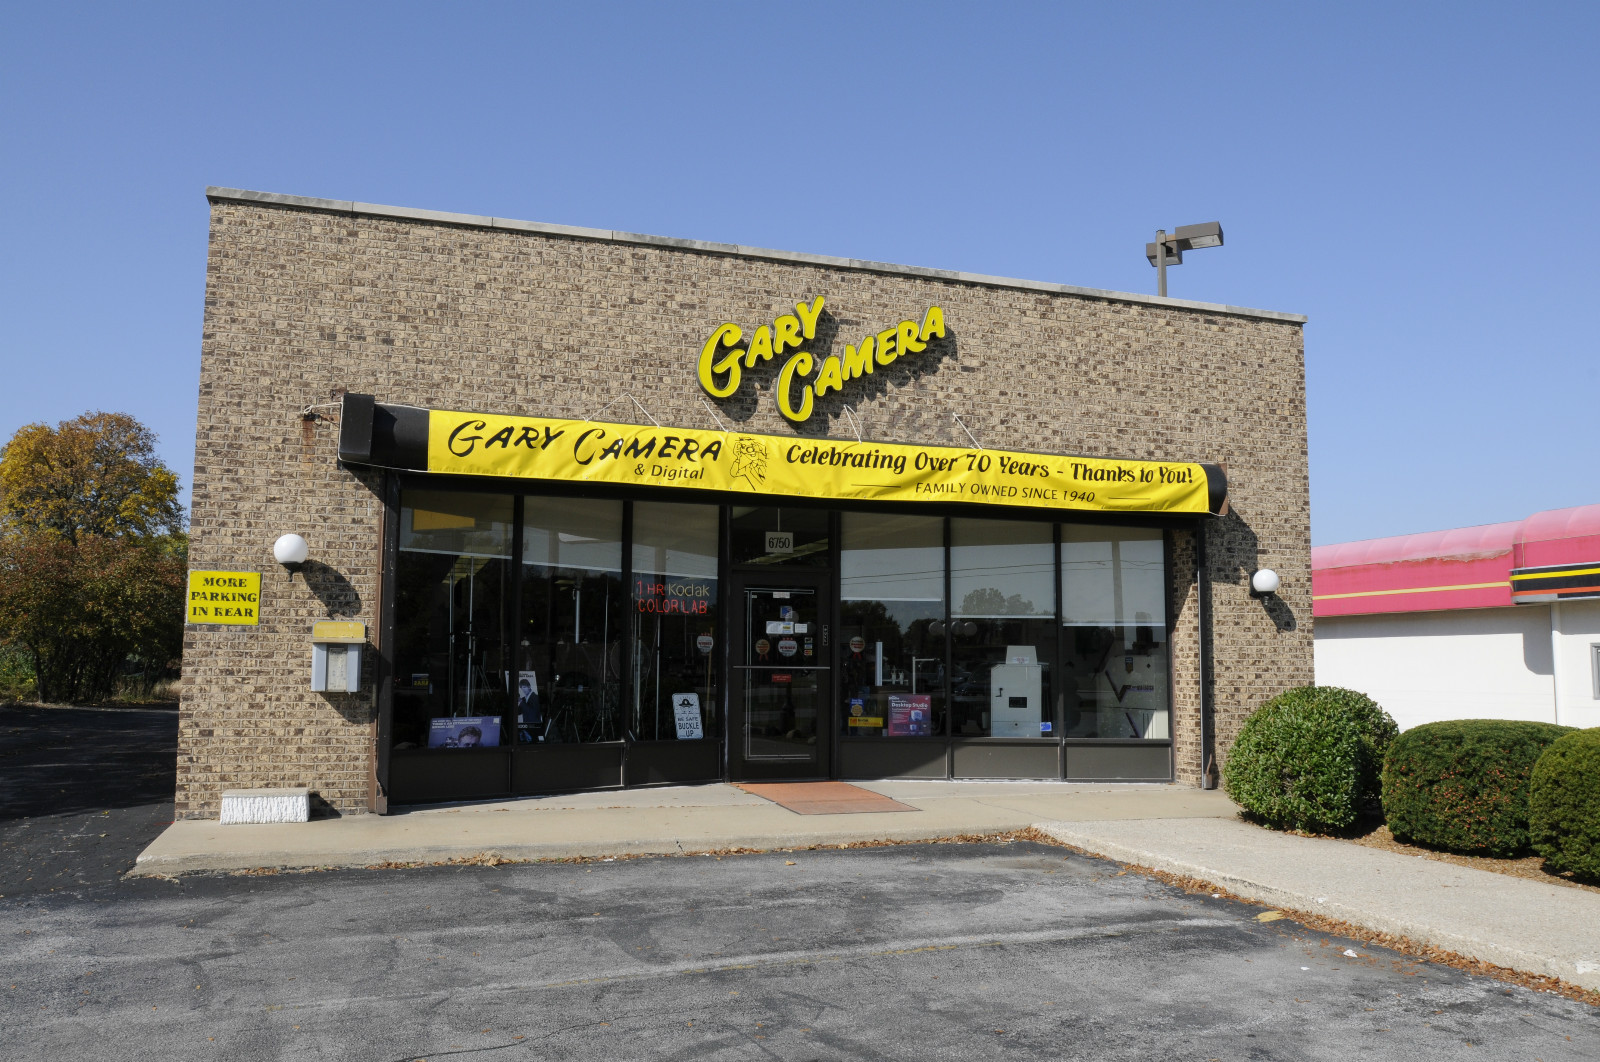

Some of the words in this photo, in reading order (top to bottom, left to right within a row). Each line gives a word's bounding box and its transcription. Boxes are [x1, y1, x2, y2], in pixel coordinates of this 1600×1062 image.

[698, 295, 825, 398] GARY
[776, 306, 945, 422] CAMERA
[448, 420, 565, 457] GARY
[574, 428, 723, 465] CAMERA
[635, 464, 646, 475] &
[651, 464, 705, 481] Digital
[787, 445, 906, 474] Celebrating
[915, 452, 958, 472] Over
[966, 454, 992, 472] 70
[1000, 456, 1050, 478] Years
[1071, 463, 1136, 482] Thanks
[1140, 467, 1154, 483] to
[1159, 466, 1194, 484] You!
[915, 482, 967, 493] FAMILY
[970, 483, 1018, 497] OWNED
[1022, 487, 1058, 500] SINCE
[1063, 490, 1096, 502] 1940
[768, 536, 790, 549] 6750
[202, 577, 247, 588] MORE
[637, 580, 643, 595] 1
[647, 583, 665, 596] HR
[668, 583, 710, 597] Kodak
[191, 591, 257, 603] PARKING
[192, 606, 208, 616] IN
[214, 607, 254, 618] REAR
[638, 598, 680, 613] COLOR
[682, 599, 708, 614] LAB
[678, 722, 700, 730] BUCKLE
[685, 729, 694, 738] UP
